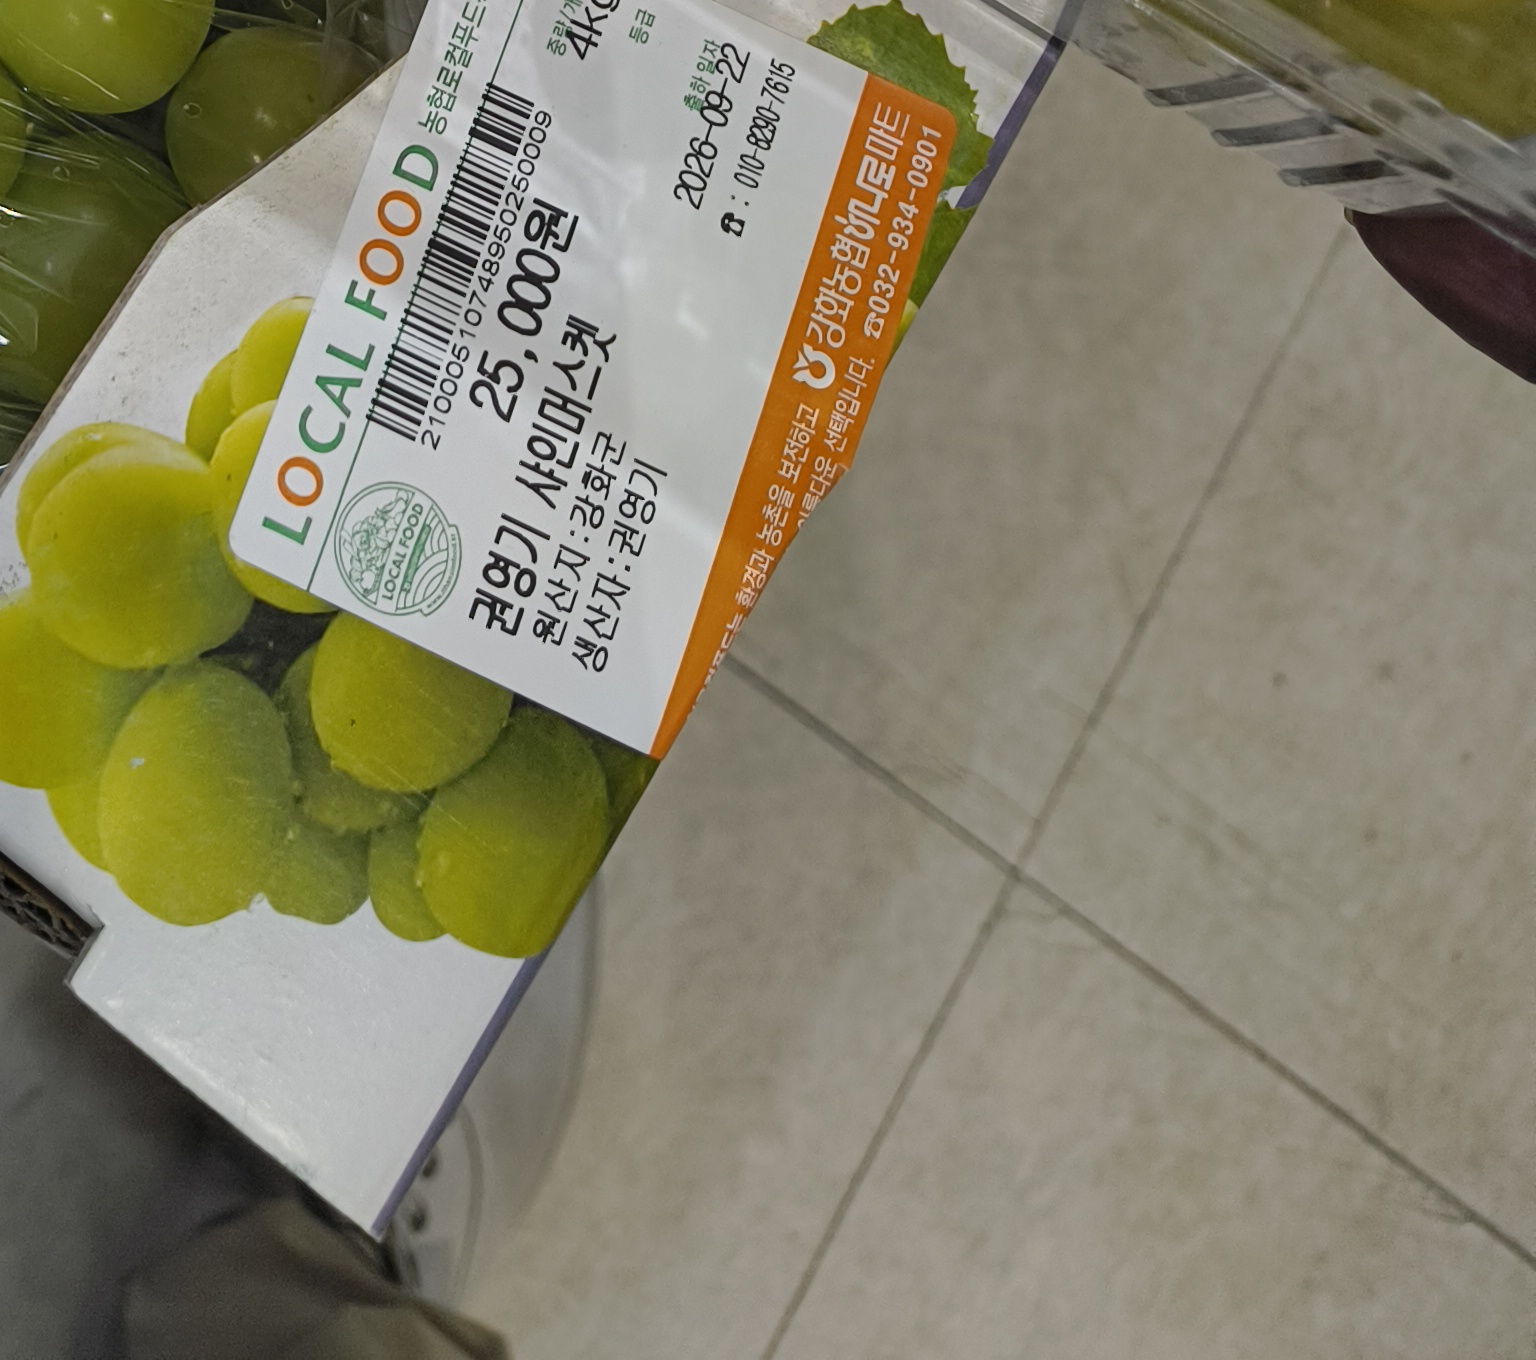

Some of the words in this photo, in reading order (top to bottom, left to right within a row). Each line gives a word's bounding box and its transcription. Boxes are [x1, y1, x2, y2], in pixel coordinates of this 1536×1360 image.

[629, 8, 656, 44] 등급
[673, 42, 751, 210] 2026-09-22
[734, 57, 796, 188] 010-8290-7615
[262, 343, 376, 545] LOCAL
[344, 144, 439, 321] FOOD
[421, 109, 552, 450] 21000510748950250009
[469, 197, 579, 422] 25,000원
[382, 550, 407, 600] LOCAL
[399, 503, 424, 549] FOOD
[469, 512, 551, 636] 권영기
[515, 313, 618, 510] 샤인머스켓
[532, 431, 627, 646] 원산지:강화군
[572, 457, 668, 672] 생산자:권영기
[735, 549, 775, 609] 환경과
[755, 483, 795, 547] 농촌을
[777, 402, 820, 484] 보전하고
